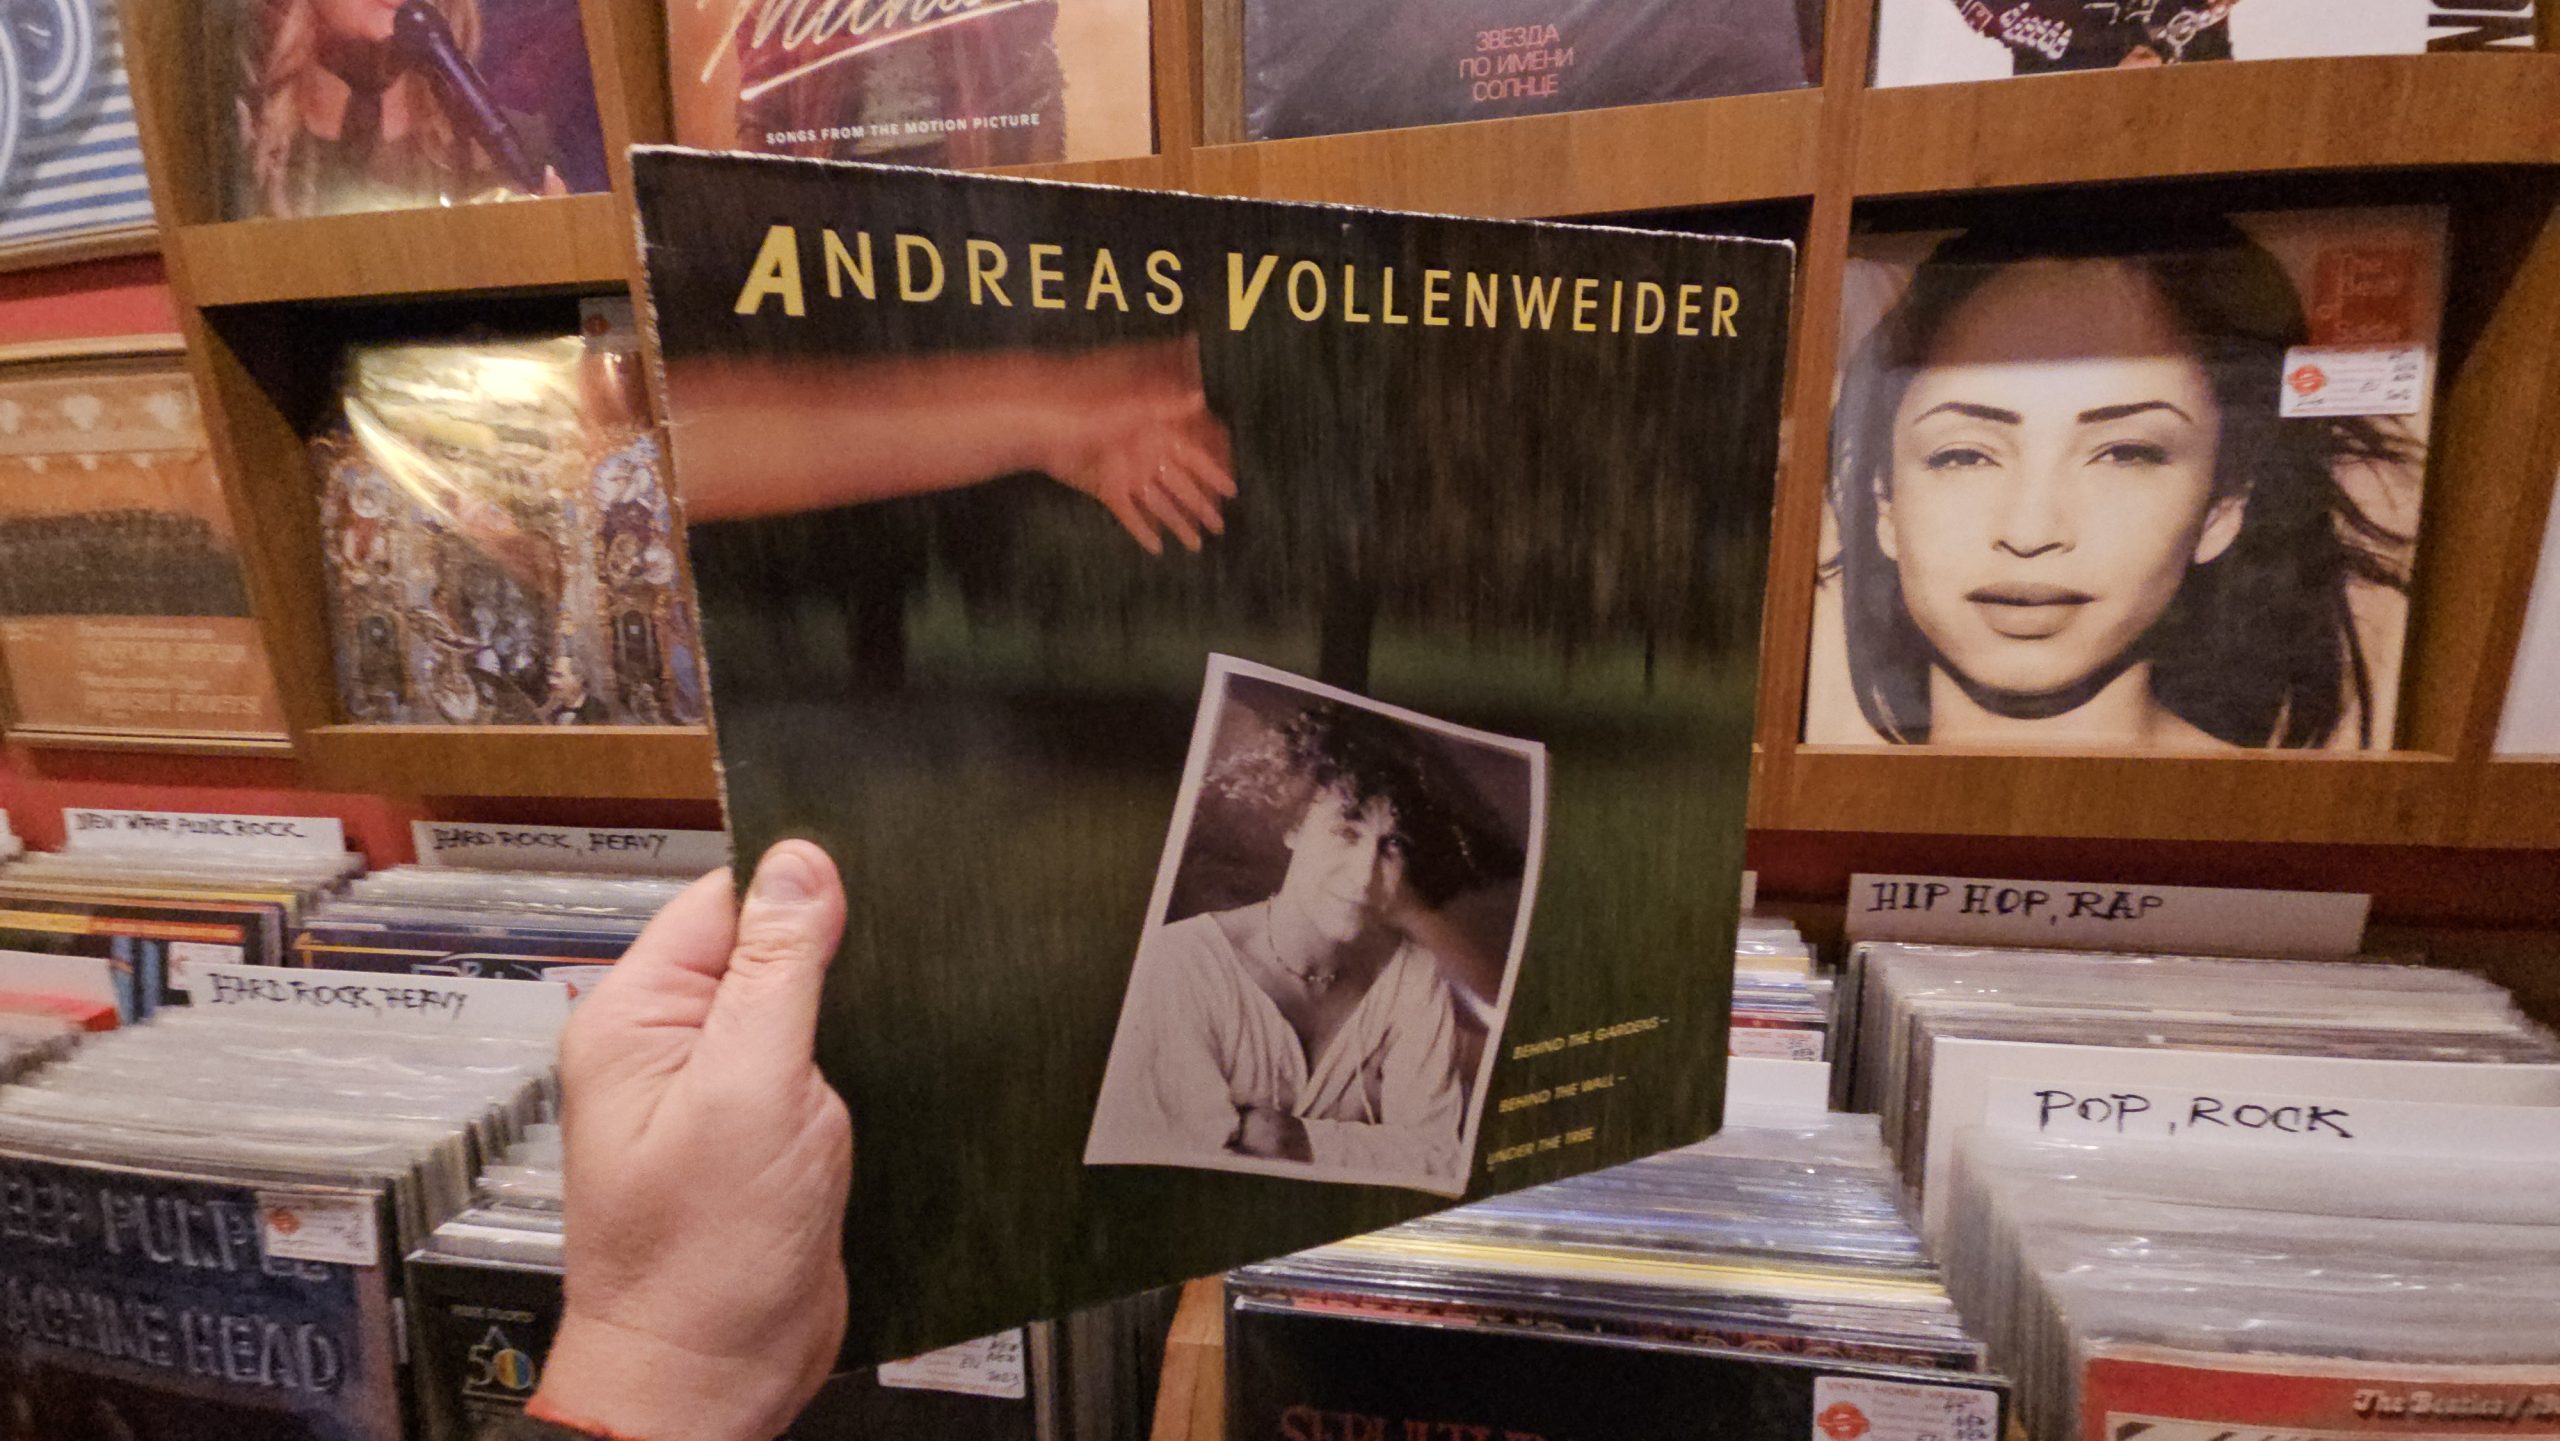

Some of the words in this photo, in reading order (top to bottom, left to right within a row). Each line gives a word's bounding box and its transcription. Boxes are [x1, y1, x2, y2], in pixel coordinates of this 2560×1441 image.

[1476, 23, 1561, 52] ЗВЕЗДА
[1459, 56, 1491, 79] ПО
[1497, 46, 1575, 75] ИМЕНИ
[765, 129, 817, 146] SONGS
[821, 125, 865, 142] FROM
[870, 122, 899, 136] THE
[904, 119, 967, 134] MOTION
[972, 113, 1041, 129] PICTURE
[734, 225, 1184, 317] ANDREAS
[1226, 251, 1741, 337] VOLLENWEIDER
[1867, 882, 1950, 913] HIP
[1959, 884, 2057, 925] HOP,
[2067, 891, 2165, 921] RAP
[1512, 1036, 1565, 1060] BEHIND
[1567, 1030, 1592, 1047] THE
[1498, 1089, 1552, 1113] BEHIND
[1554, 1082, 1579, 1100] THE
[1580, 1073, 1615, 1092] WALL
[2189, 1096, 2355, 1138] ROCK
[1537, 1135, 1562, 1151] THE
[1564, 1126, 1595, 1145] TREE
[180, 1308, 340, 1392] HEAD
[2352, 1388, 2401, 1414] The
